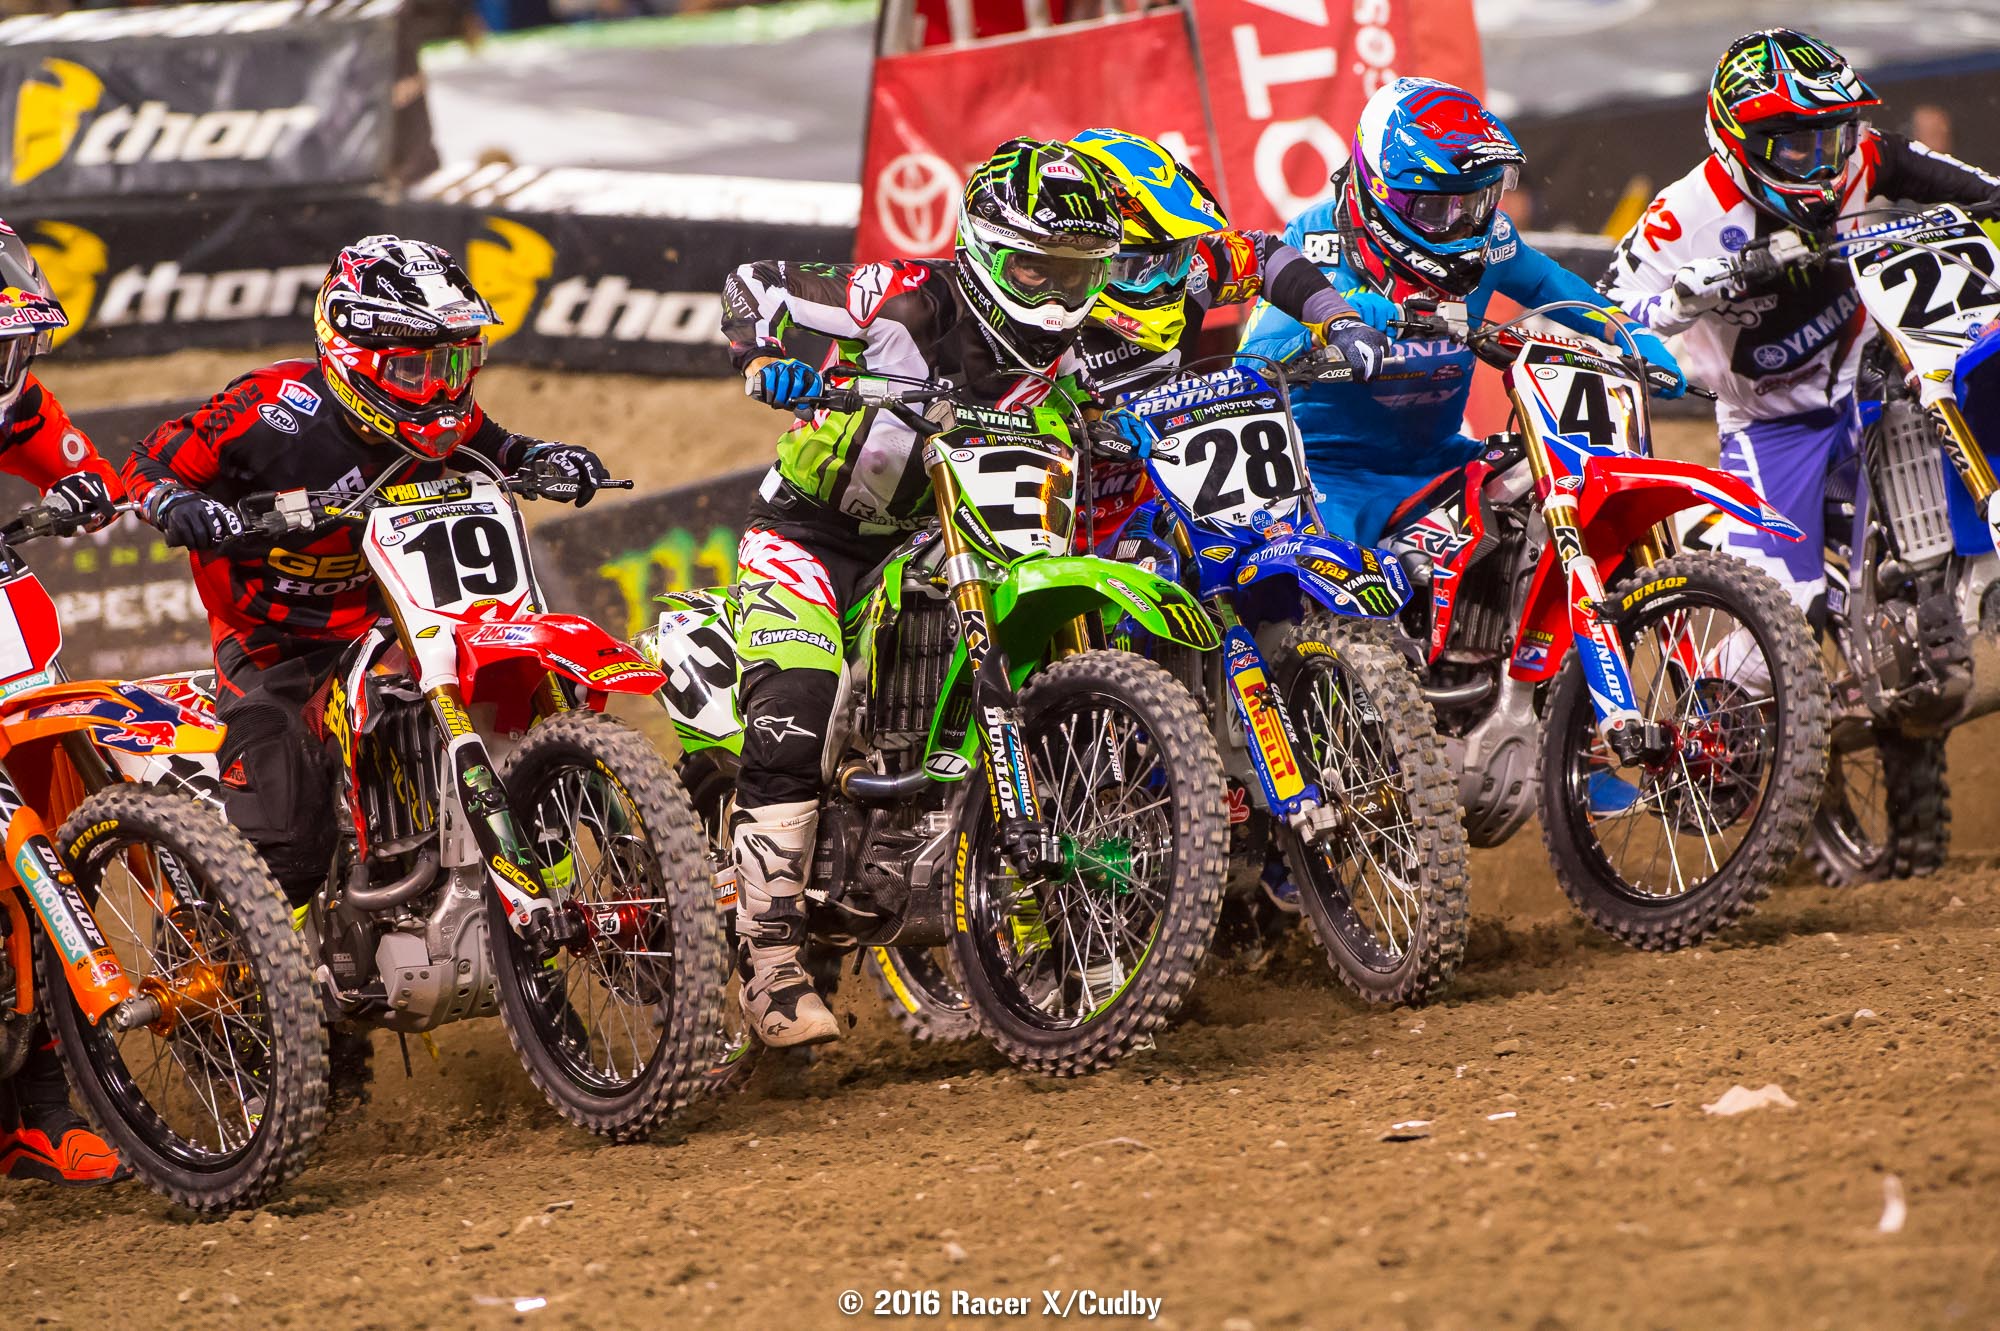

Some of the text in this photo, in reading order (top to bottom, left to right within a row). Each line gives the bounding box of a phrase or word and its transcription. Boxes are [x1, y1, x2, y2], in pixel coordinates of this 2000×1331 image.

[74, 101, 320, 166] thor
[1047, 165, 1078, 178] BELL
[1369, 220, 1448, 279] RIDE RED
[1489, 244, 1517, 265] WPS
[405, 261, 442, 272] Arai
[1879, 241, 2000, 330] 22
[1046, 319, 1062, 327] BELL
[1318, 367, 1351, 381] ARC
[283, 384, 316, 411] 100%
[326, 366, 396, 436] GEICO
[1204, 399, 1256, 415] MONSTER
[1558, 371, 1617, 447] 4
[266, 407, 295, 431] Arai
[956, 408, 1033, 430] RENTHAL
[996, 434, 1045, 448] MONSTER
[1099, 438, 1132, 454] ARC
[1184, 419, 1297, 521] 28
[546, 483, 578, 493] ARC
[977, 449, 1074, 541] 3
[426, 503, 475, 518] MONSTER
[957, 506, 993, 547] Kawasaki
[1259, 541, 1304, 560] TOYOTA
[1400, 525, 1476, 558] CRF
[403, 516, 519, 609] 19
[1343, 573, 1386, 592] YAMAHA
[1622, 576, 1688, 612] DUNLOP
[750, 629, 836, 656] Kawasaki
[1296, 639, 1340, 661] PIRELLI
[546, 652, 588, 674] DUNLOP
[587, 662, 658, 683] GEICO
[1586, 620, 1625, 705] DUNLOP
[4, 671, 49, 696] MOTOREX
[602, 669, 663, 687] HONDA
[1243, 681, 1288, 781] PIRELLI
[983, 705, 1017, 819] DUNLOP
[1014, 750, 1035, 816] CARRILLO
[69, 818, 120, 859] DUNLOP
[491, 855, 541, 895] GEICO
[954, 831, 969, 934] DUNLOP
[33, 880, 85, 960] MOTOREX
